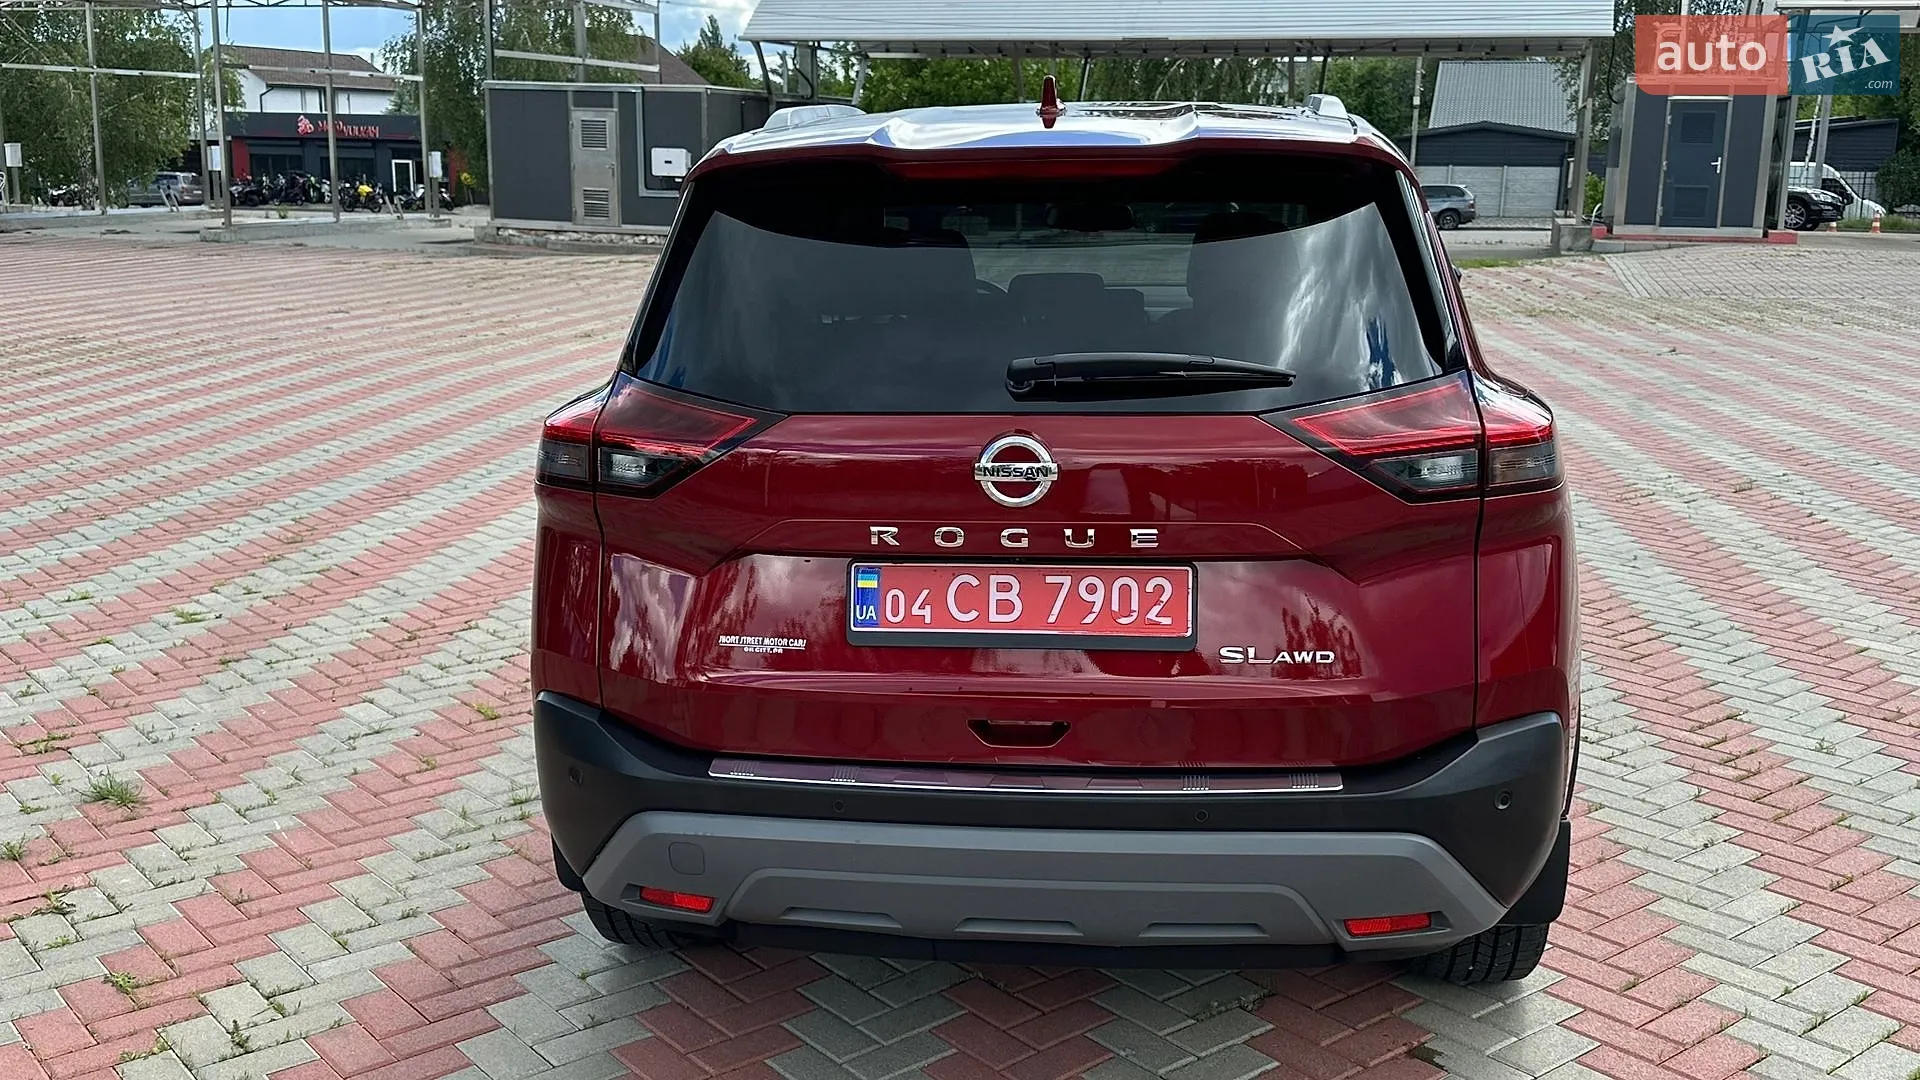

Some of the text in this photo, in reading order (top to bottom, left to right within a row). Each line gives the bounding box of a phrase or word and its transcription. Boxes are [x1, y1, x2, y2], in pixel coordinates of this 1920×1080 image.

[983, 466, 1049, 479] NISSAN
[869, 525, 1160, 549] ROGUE
[885, 573, 1173, 626] 04 CB 7902
[855, 604, 877, 621] UA
[739, 636, 763, 645] STREET
[763, 637, 788, 647] MOTOR
[788, 638, 807, 647] CARS
[1219, 645, 1336, 665] SL AWD
